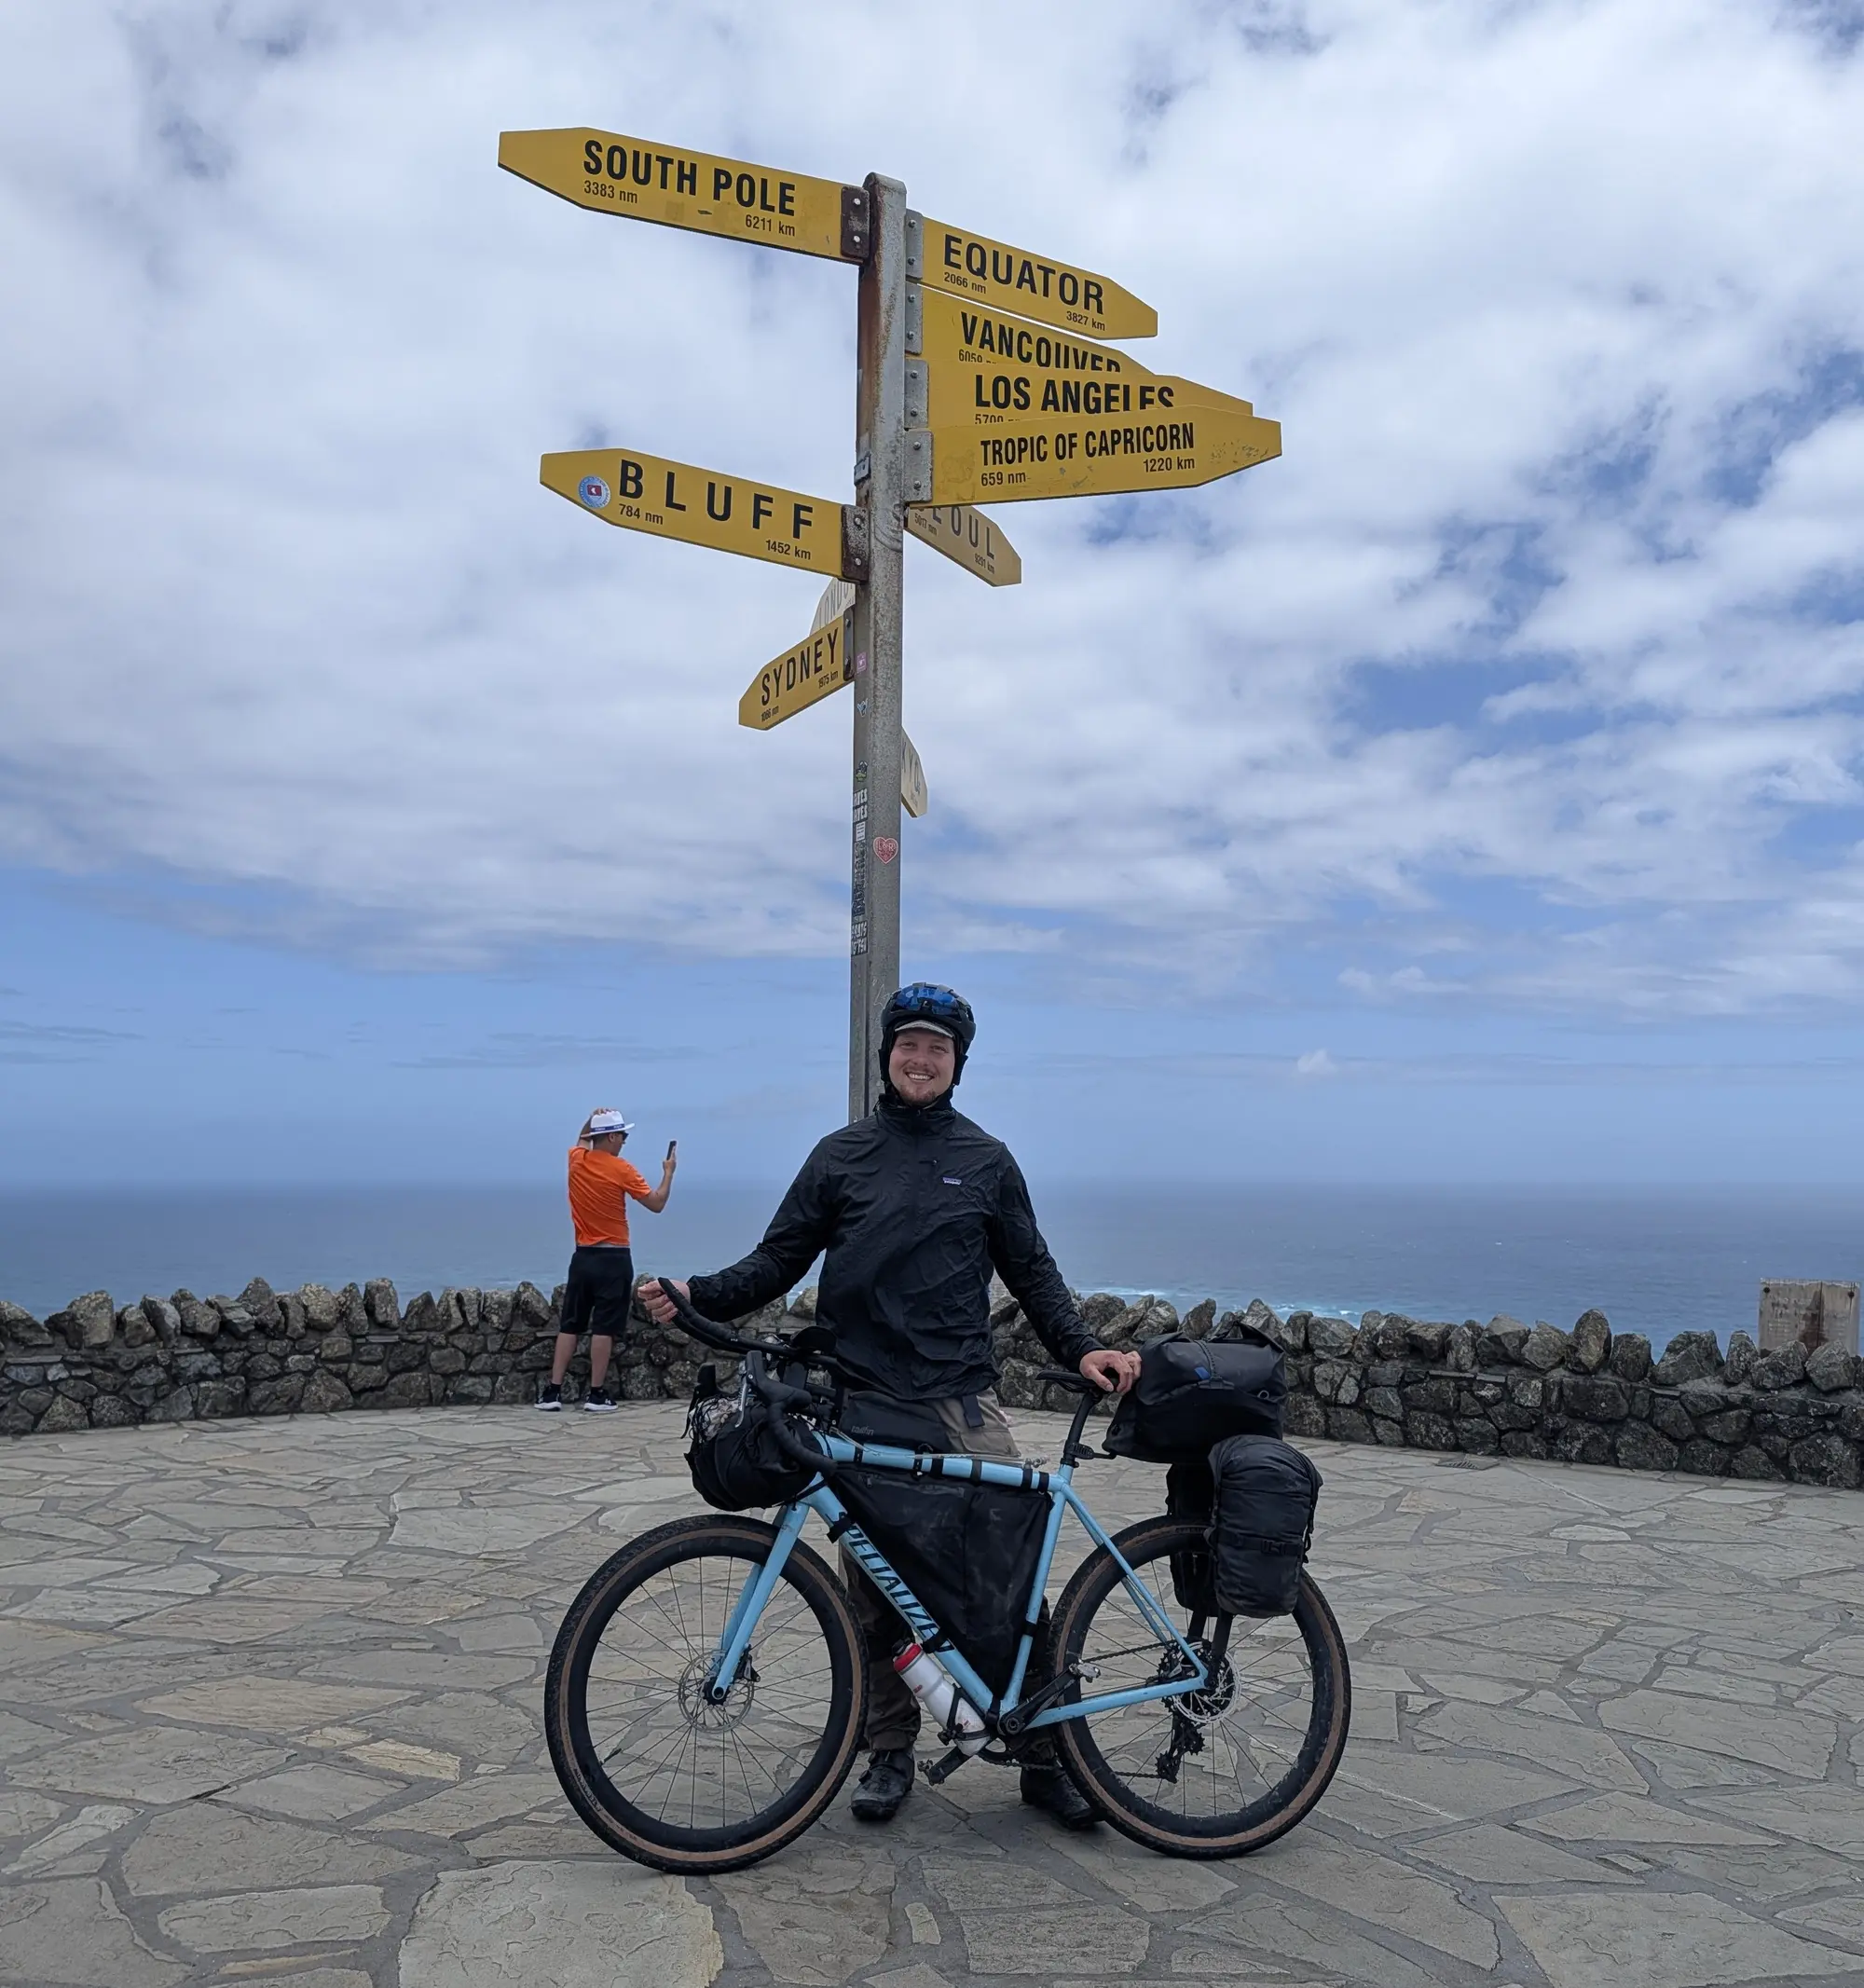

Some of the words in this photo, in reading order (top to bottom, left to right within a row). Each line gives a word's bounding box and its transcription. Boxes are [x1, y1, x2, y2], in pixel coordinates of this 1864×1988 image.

[583, 139, 697, 197] SOUTH
[713, 167, 796, 217] POLE
[583, 180, 615, 199] 3383
[620, 190, 638, 204] nm
[745, 213, 772, 232] 6211
[778, 220, 796, 237] km
[943, 271, 968, 288] 2066
[971, 281, 986, 295] nm
[944, 233, 1103, 315] EQUATOR
[1065, 310, 1090, 326] 3827
[1091, 317, 1105, 332] km
[975, 374, 1031, 410] LOS
[1040, 378, 1174, 415] ANGELES
[980, 434, 1048, 466] TROPIC
[1054, 432, 1078, 460] OF
[1085, 422, 1195, 459] CAPRICORN
[1143, 458, 1172, 473] 1220
[1176, 456, 1196, 471] km
[980, 472, 1004, 487] 659
[1007, 472, 1026, 485] nm
[619, 459, 814, 539] BLUFF
[618, 502, 641, 520] 784
[645, 512, 664, 526] nm
[916, 506, 994, 560] EOUL
[765, 539, 791, 555] 1452
[795, 545, 812, 560] km
[761, 627, 839, 706] SYDNEY
